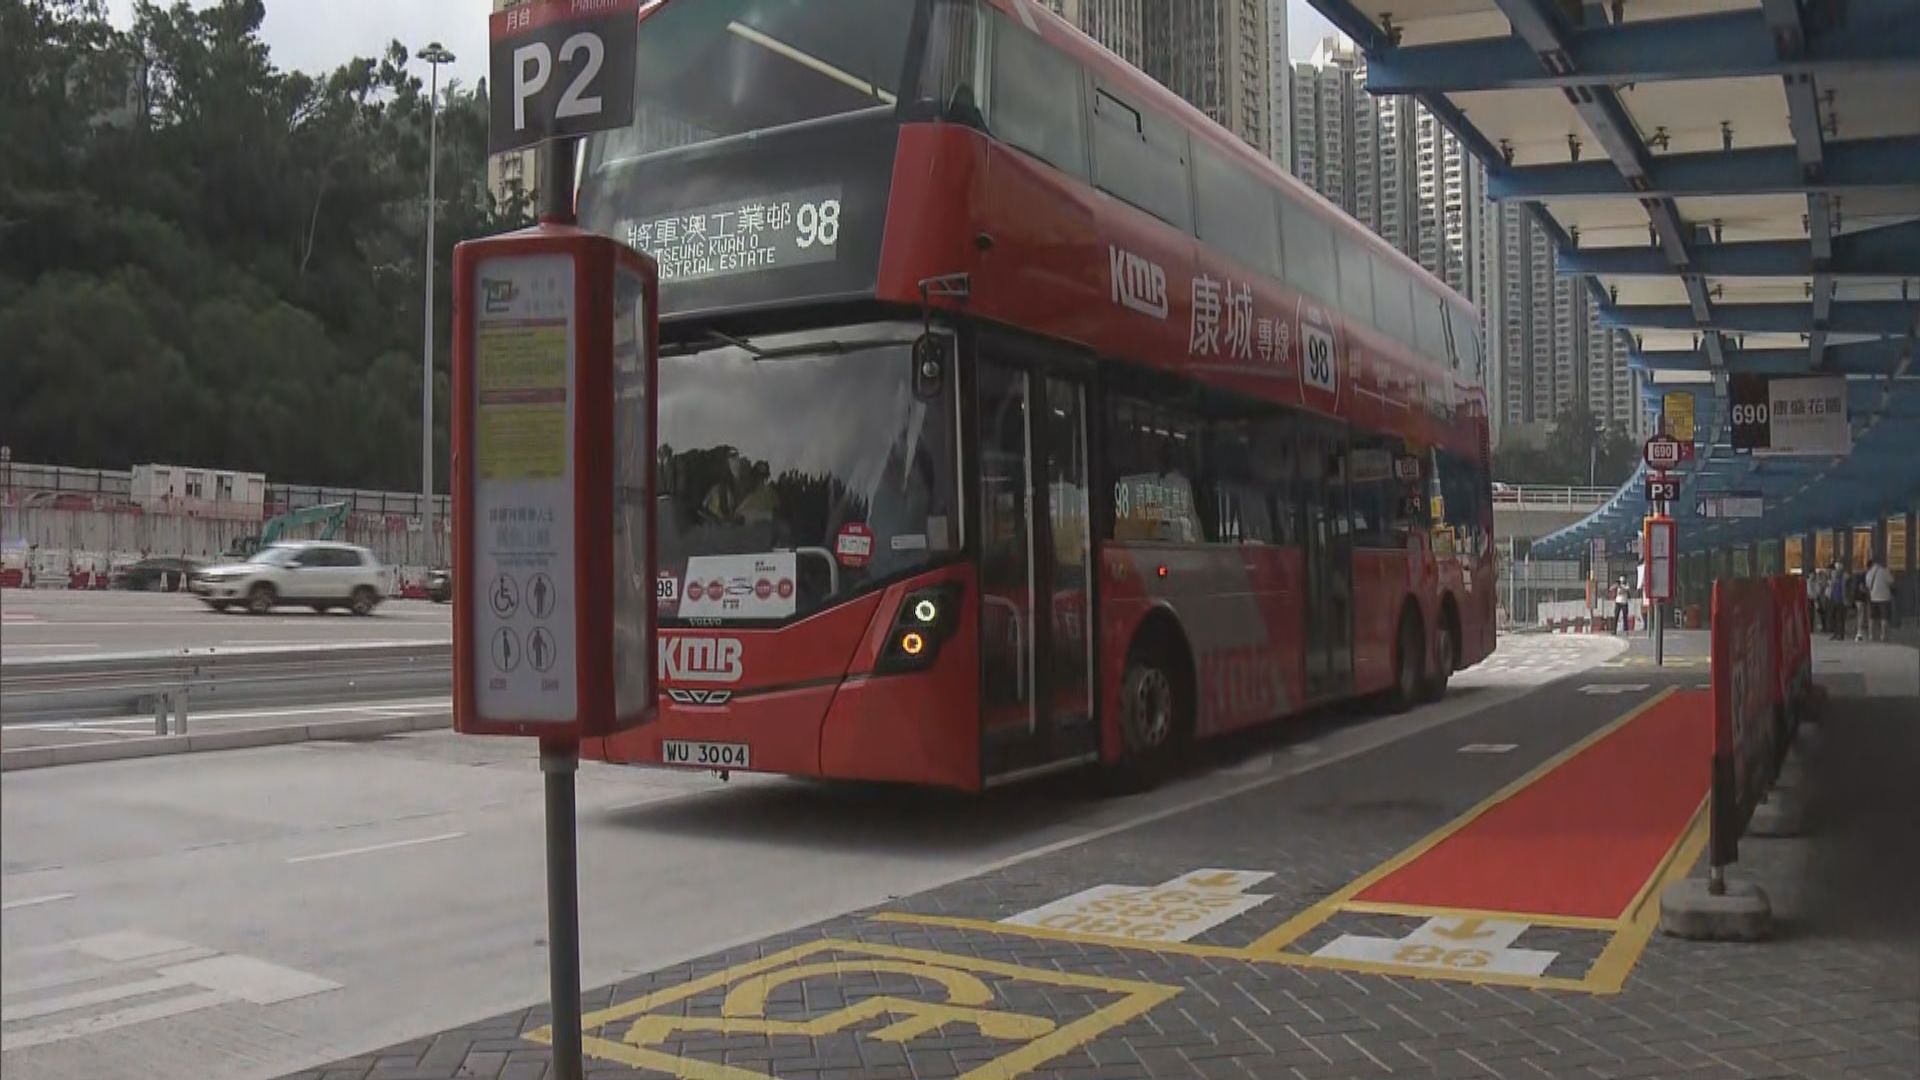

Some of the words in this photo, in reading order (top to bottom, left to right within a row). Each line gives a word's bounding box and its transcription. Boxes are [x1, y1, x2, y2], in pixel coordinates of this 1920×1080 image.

[507, 8, 531, 32] 月台
[513, 32, 605, 131] P2
[628, 203, 791, 250] 將軍澳工業邨
[796, 200, 840, 248] 98
[654, 241, 704, 263] TSEUNG
[709, 236, 745, 255] KWAN
[749, 233, 758, 248] O
[657, 258, 714, 279] USTRIAL
[720, 246, 775, 270] ESTATE
[1308, 334, 1329, 384] 98
[1732, 403, 1767, 424] 690
[1653, 446, 1672, 458] 690
[1114, 482, 1129, 519] 98
[1651, 483, 1674, 499] P3
[656, 580, 673, 598] 98
[689, 617, 722, 627] VOLVO
[666, 742, 689, 761] WU
[698, 746, 745, 765] 3004
[1393, 945, 1493, 968] 98
